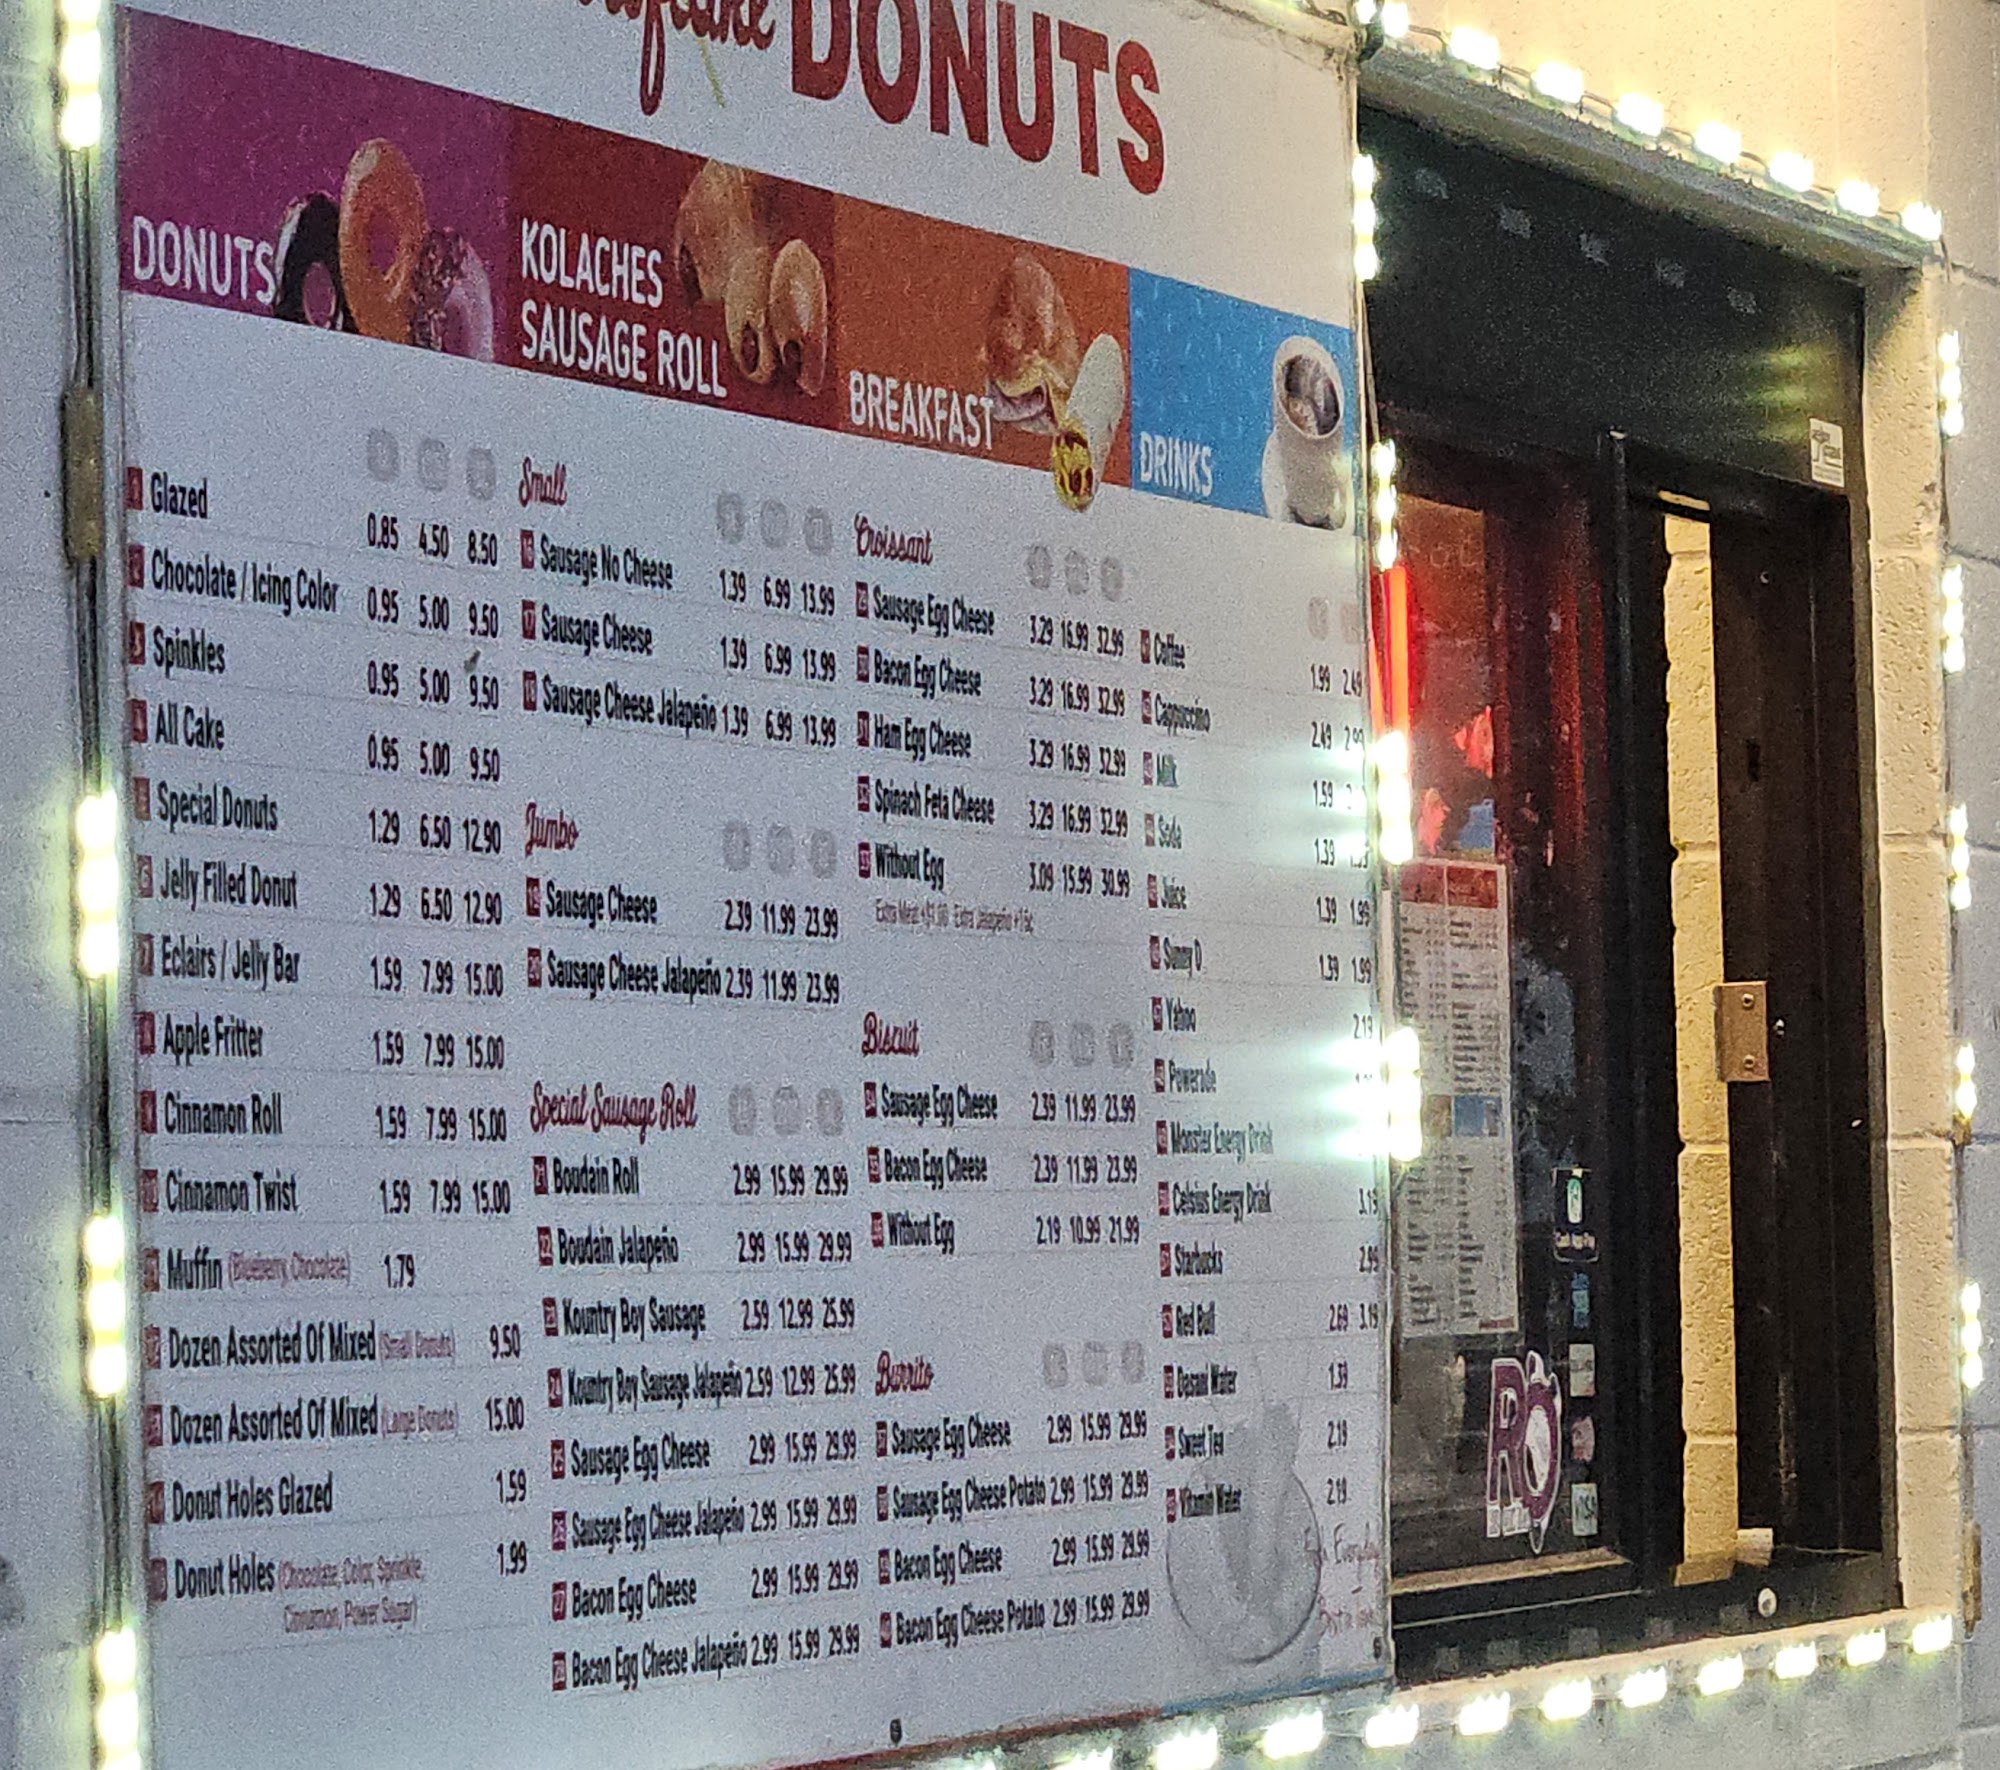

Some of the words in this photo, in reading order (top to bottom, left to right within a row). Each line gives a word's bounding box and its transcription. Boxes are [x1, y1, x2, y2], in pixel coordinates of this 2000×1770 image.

[791, 0, 1164, 195] DONUTS
[133, 215, 274, 302] DONUTS
[522, 218, 662, 307] KOLACHES
[521, 300, 647, 384] SAUSAGE
[657, 331, 726, 397] ROLL
[850, 372, 994, 448] BREAKFAST
[519, 456, 568, 507] Small
[1140, 432, 1212, 497] DRINKS
[150, 472, 208, 519] Glazed
[367, 512, 399, 550] 0.85
[419, 523, 449, 558] 4.50
[468, 530, 498, 566] 8.50
[151, 548, 236, 598] Chocolate
[240, 561, 248, 601] /
[252, 562, 291, 617] Icing
[296, 569, 339, 612] Color
[367, 587, 399, 624] 0.95
[419, 595, 449, 630] 5.00
[468, 602, 498, 638] 9.50
[540, 533, 597, 587] Sausage
[601, 544, 620, 582] No
[624, 547, 672, 590] Cheese
[720, 569, 746, 603] 1.39
[764, 575, 790, 609] 6.99
[802, 581, 835, 616] 13.99
[542, 604, 599, 656] Sausage
[603, 612, 653, 655] Cheese
[721, 635, 747, 669] 1.39
[765, 642, 791, 676] 6.99
[803, 648, 836, 681] 13.99
[873, 585, 925, 634] Sausage
[927, 593, 949, 638] Egg
[952, 596, 994, 635] Cheese
[1029, 615, 1053, 646] 3.29
[1061, 620, 1089, 651] 16.99
[1097, 625, 1124, 656] 32.99
[368, 661, 399, 697] 0.95
[419, 667, 450, 704] 5.00
[470, 675, 498, 710] 9.50
[542, 674, 600, 725] Sausage
[605, 680, 654, 724] Cheese
[722, 704, 748, 737] 1.39
[766, 709, 792, 742] 6.99
[803, 713, 836, 747] 13.99
[155, 702, 178, 745] All
[183, 707, 225, 750] Cake
[368, 734, 399, 772] 0.95
[420, 742, 450, 777] 5.00
[470, 748, 499, 781] 9.50
[157, 781, 217, 833] Special
[222, 787, 278, 831] Donuts
[369, 809, 400, 845] 1.29
[420, 813, 451, 850] 6.50
[463, 818, 501, 854] 12.90
[160, 858, 199, 911] Jelly
[203, 861, 246, 905] Filled
[251, 866, 298, 909] Donut
[370, 883, 401, 918] 1.29
[421, 887, 452, 922] 6.50
[464, 891, 502, 925] 12.90
[546, 880, 604, 929] Sausage
[608, 884, 657, 924] Cheese
[724, 899, 751, 932] 2.39
[762, 901, 796, 935] 11.99
[805, 905, 838, 939] 23.99
[162, 936, 215, 979] Eclairs
[221, 939, 227, 981] /
[232, 939, 269, 991] Jelly
[273, 942, 300, 984] Bar
[371, 956, 402, 992] 1.59
[422, 959, 453, 994] 7.99
[465, 962, 503, 997] 15.00
[547, 950, 604, 999] Sausage
[609, 952, 658, 994] Cheese
[726, 967, 752, 999] 2.39
[763, 970, 797, 1001] 11.99
[806, 972, 839, 1004] 23.99
[163, 1013, 209, 1066] Apple
[215, 1017, 263, 1058] Fritter
[373, 1031, 404, 1065] 1.59
[424, 1033, 455, 1067] 7.99
[466, 1035, 504, 1070] 15.00
[164, 1091, 246, 1135] Cinnamon
[251, 1093, 283, 1134] Roll
[375, 1106, 407, 1140] 1.59
[426, 1107, 457, 1142] 7.99
[469, 1108, 507, 1142] 15.00
[530, 1080, 587, 1133] Special
[591, 1082, 657, 1144] Sausage
[932, 1084, 954, 1127] Egg
[957, 1084, 997, 1119] Cheese
[1032, 1092, 1056, 1121] 2.39
[1066, 1094, 1096, 1122] 11.99
[1105, 1093, 1136, 1123] 23.99
[165, 1169, 249, 1213] Cinnamon
[253, 1169, 297, 1212] Twist
[380, 1180, 411, 1214] 1.59
[430, 1181, 461, 1214] 7.99
[472, 1180, 511, 1214] 15.00
[553, 1154, 609, 1195] Boudain
[613, 1156, 639, 1195] Roll
[733, 1163, 760, 1196] 2.99
[770, 1164, 805, 1196] 15.99
[814, 1165, 848, 1196] 29.99
[167, 1246, 222, 1290] Muffin
[384, 1254, 415, 1289] 1.79
[169, 1327, 221, 1367] Dozen
[228, 1322, 300, 1366] Assorted
[306, 1321, 325, 1362] Of
[328, 1319, 376, 1362] Mixed
[490, 1324, 521, 1358] 9.50
[170, 1404, 222, 1444] Dozen
[228, 1398, 301, 1443] Assorted
[307, 1395, 325, 1437] Of
[331, 1393, 378, 1438] Mixed
[485, 1396, 524, 1431] 15.00
[571, 1439, 629, 1484] Sausage
[633, 1435, 659, 1481] Egg
[662, 1432, 710, 1470] Cheese
[749, 1434, 775, 1465] 2.99
[785, 1431, 817, 1463] 15.99
[825, 1430, 856, 1460] 29.99
[172, 1481, 220, 1521] Donut
[226, 1476, 274, 1517] Holes
[278, 1471, 333, 1515] Glazed
[496, 1468, 527, 1504] 1.59
[175, 1558, 223, 1599] Donut
[229, 1552, 275, 1597] Holes
[496, 1541, 528, 1576] 1.99
[572, 1581, 614, 1618] Bacon
[618, 1576, 643, 1622] Egg
[647, 1570, 697, 1609] Cheese
[752, 1567, 778, 1598] 2.99
[788, 1563, 819, 1594] 15.99
[828, 1559, 858, 1591] 29.99
